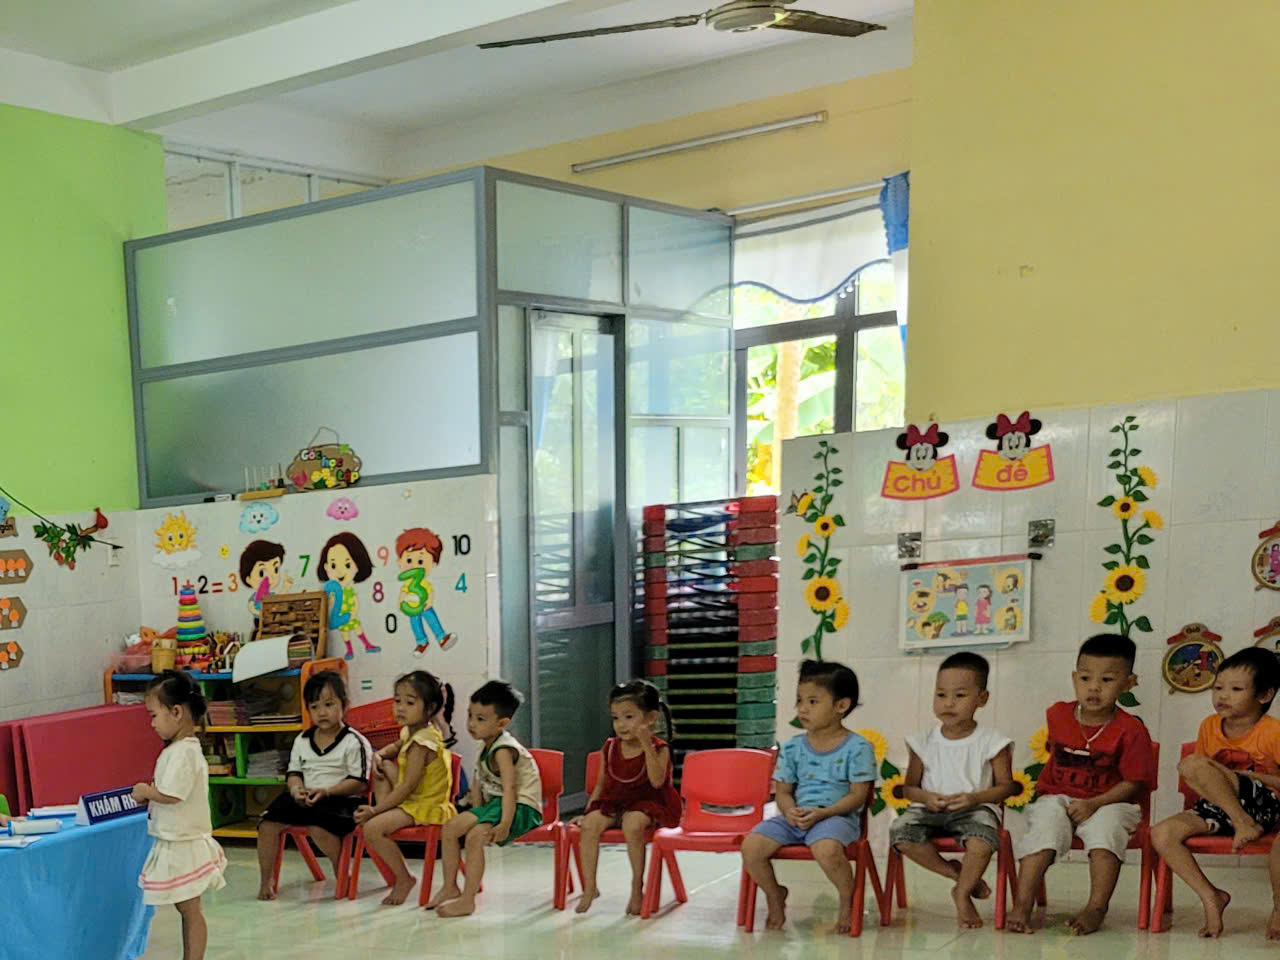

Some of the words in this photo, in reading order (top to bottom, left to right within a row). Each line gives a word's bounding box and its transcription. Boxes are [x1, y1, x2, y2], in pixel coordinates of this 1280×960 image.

[893, 470, 941, 492] Chủ
[377, 546, 389, 566] 9
[452, 534, 470, 556] 10
[299, 554, 310, 577] 7
[372, 581, 385, 603] 8
[454, 573, 468, 593] 4
[88, 796, 122, 818] KHÁM
[120, 793, 138, 811] RH
